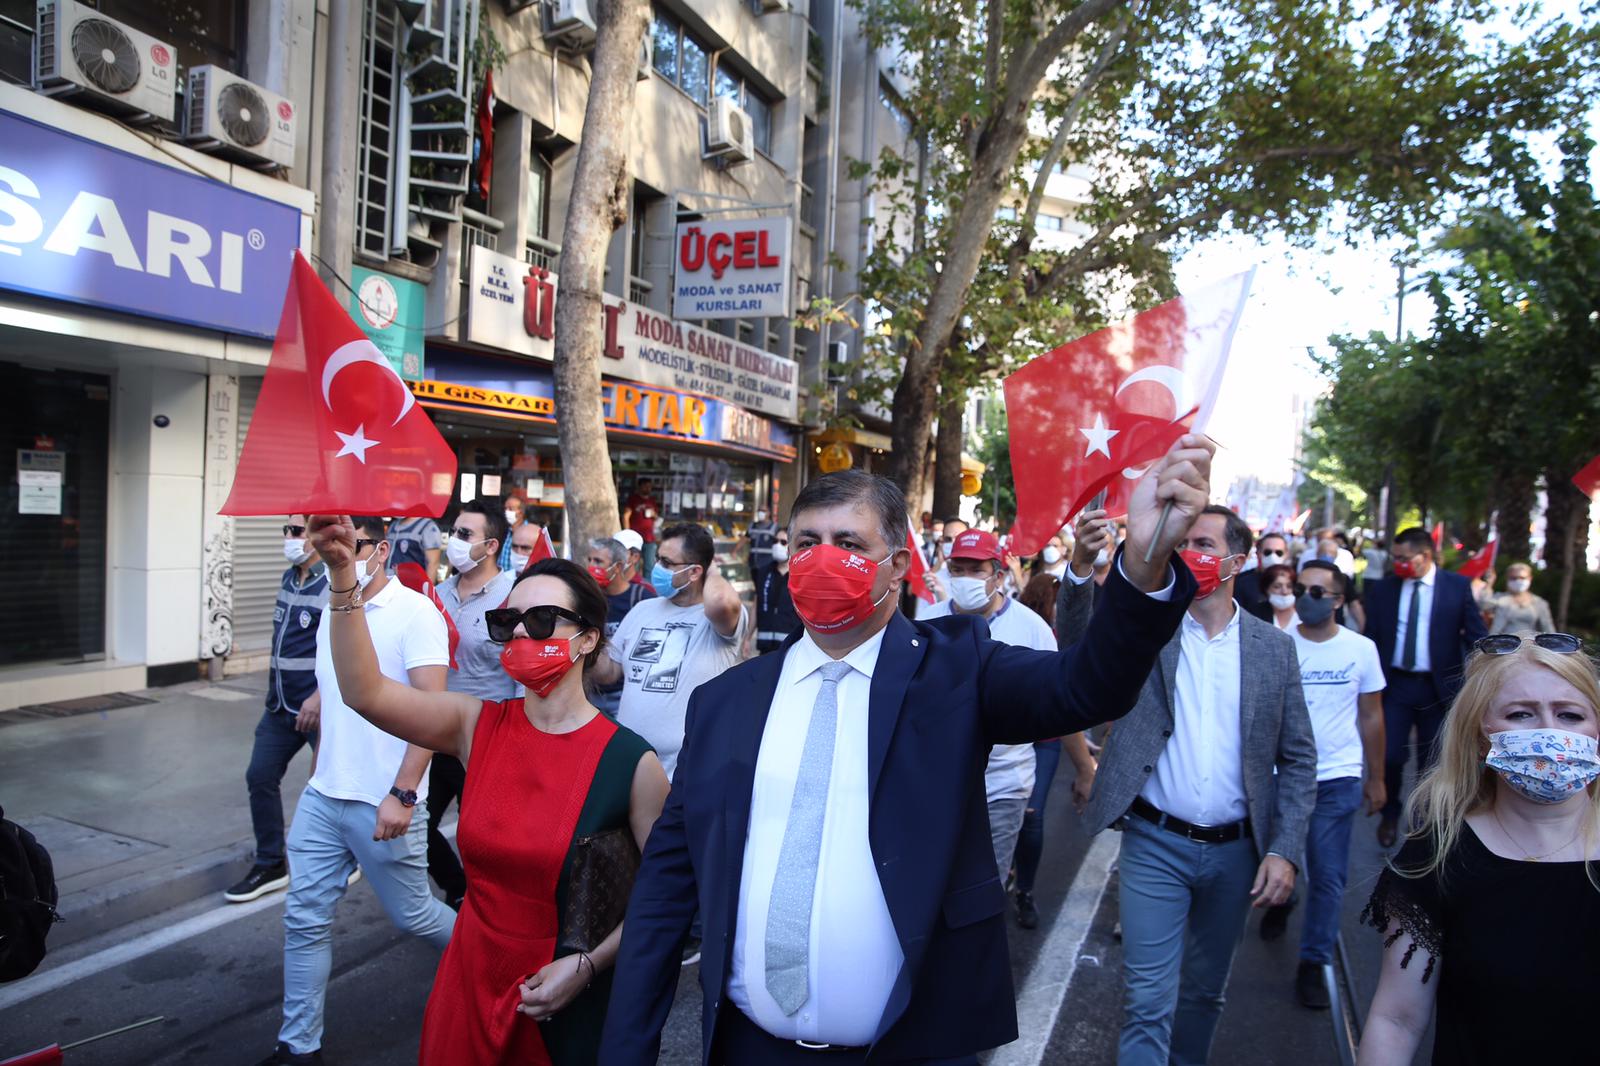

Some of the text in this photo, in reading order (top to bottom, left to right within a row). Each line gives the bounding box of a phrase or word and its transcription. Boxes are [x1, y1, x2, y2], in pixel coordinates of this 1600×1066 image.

[152, 66, 167, 80] LG
[680, 227, 780, 280] ÜÇEL
[679, 283, 782, 296] MODA ve SANAT
[696, 300, 762, 312] KURSLARI
[635, 311, 684, 349] MODA
[687, 330, 733, 365] SANAT
[735, 343, 793, 384] KURSLARI
